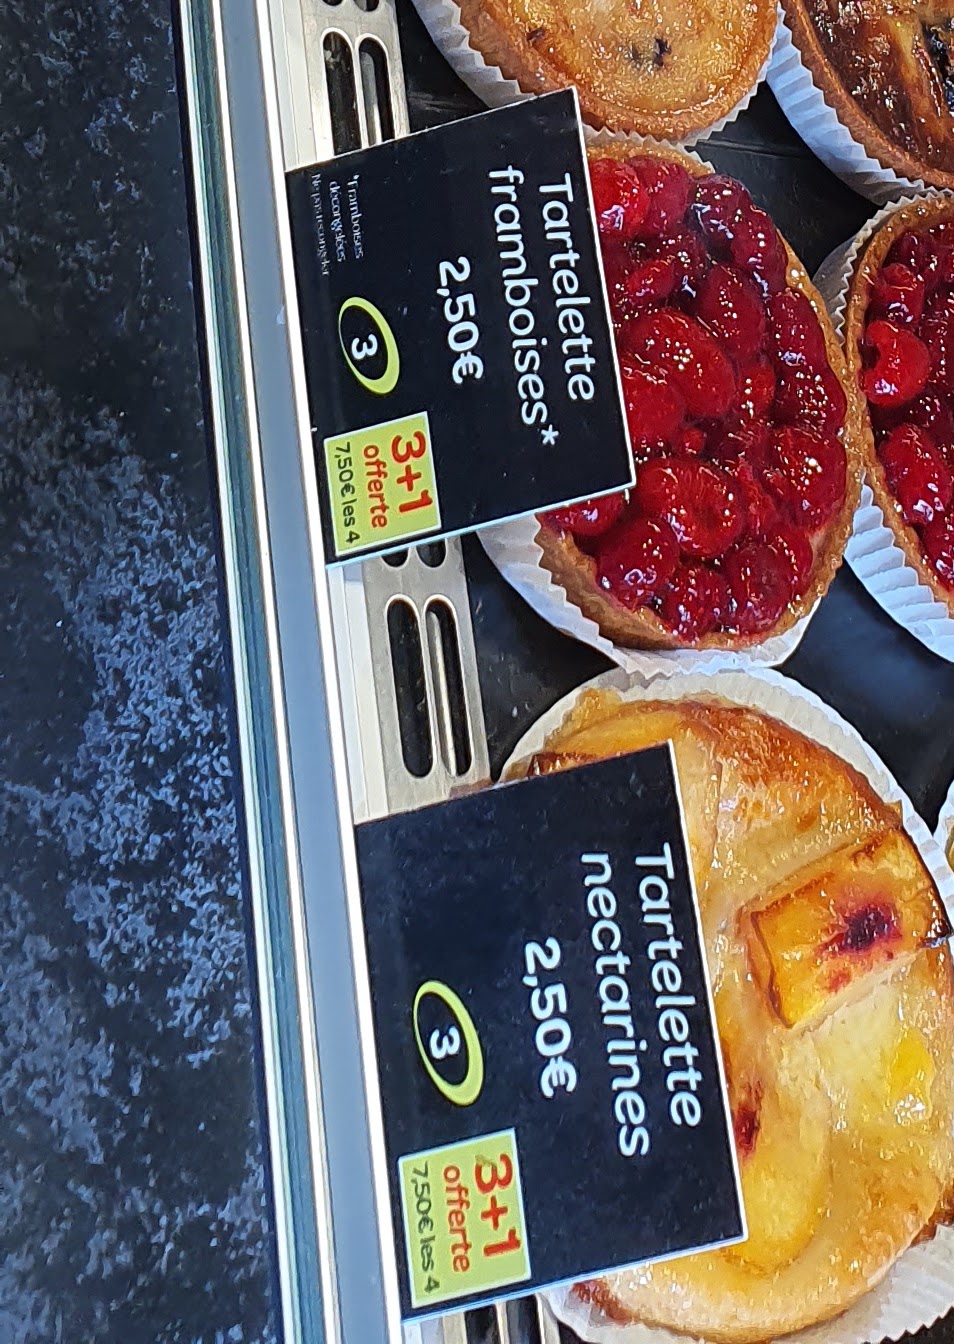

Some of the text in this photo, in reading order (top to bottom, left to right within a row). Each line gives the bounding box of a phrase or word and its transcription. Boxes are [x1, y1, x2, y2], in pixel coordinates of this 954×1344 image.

[436, 257, 484, 385] 2,50€
[538, 172, 596, 401] Tartelette
[350, 334, 379, 361] 3
[334, 441, 361, 544] 7,50€ les 4
[363, 443, 389, 530] offerte
[390, 430, 434, 515] 3+1
[524, 935, 578, 1100] 2,50€
[580, 851, 650, 1158] nectarines
[634, 842, 703, 1129] Tartelette
[429, 1026, 462, 1061] 3
[408, 1161, 441, 1295] 7,50€ les 4
[442, 1165, 471, 1274] offerte
[474, 1153, 522, 1258] 3+1
